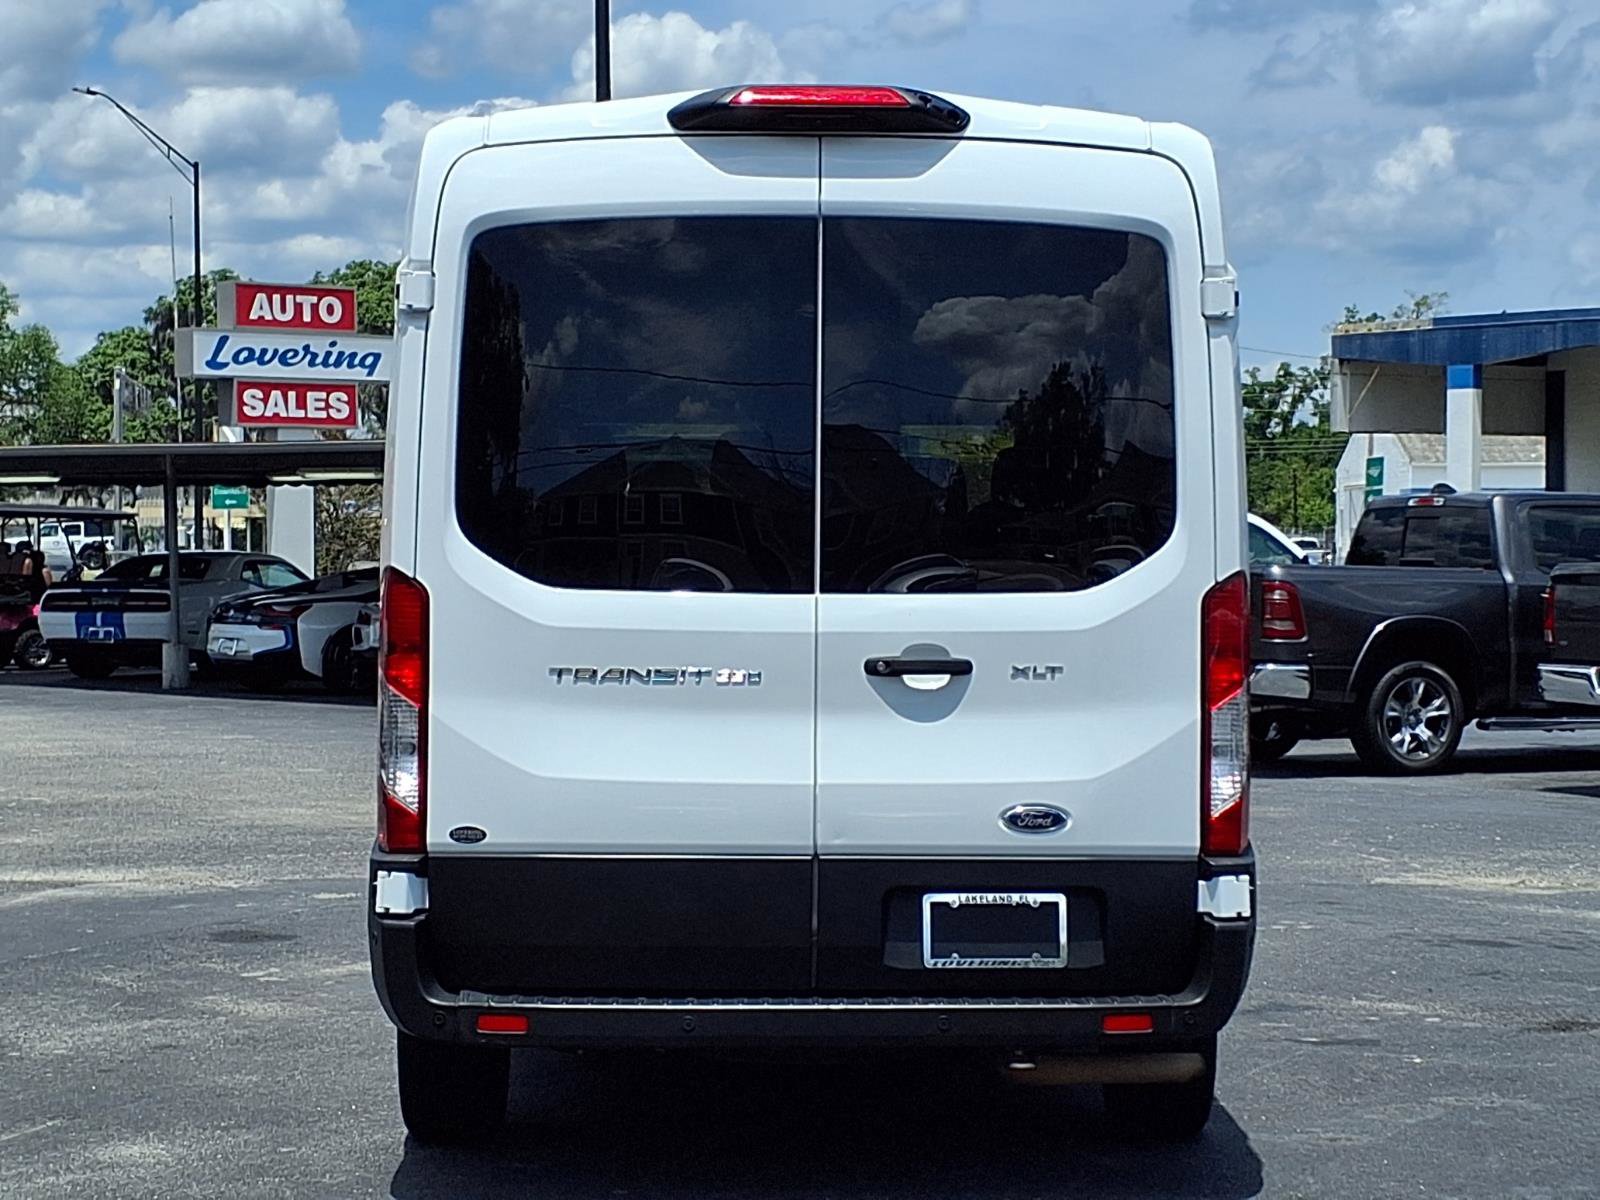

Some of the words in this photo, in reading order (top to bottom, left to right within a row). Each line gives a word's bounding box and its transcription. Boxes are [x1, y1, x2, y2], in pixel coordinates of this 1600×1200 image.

[249, 293, 343, 324] AUTO
[205, 335, 382, 377] Lovering
[242, 388, 350, 419] SALES
[549, 667, 712, 685] TRANSIT
[1010, 665, 1063, 681] XLT
[1017, 811, 1053, 826] Ford
